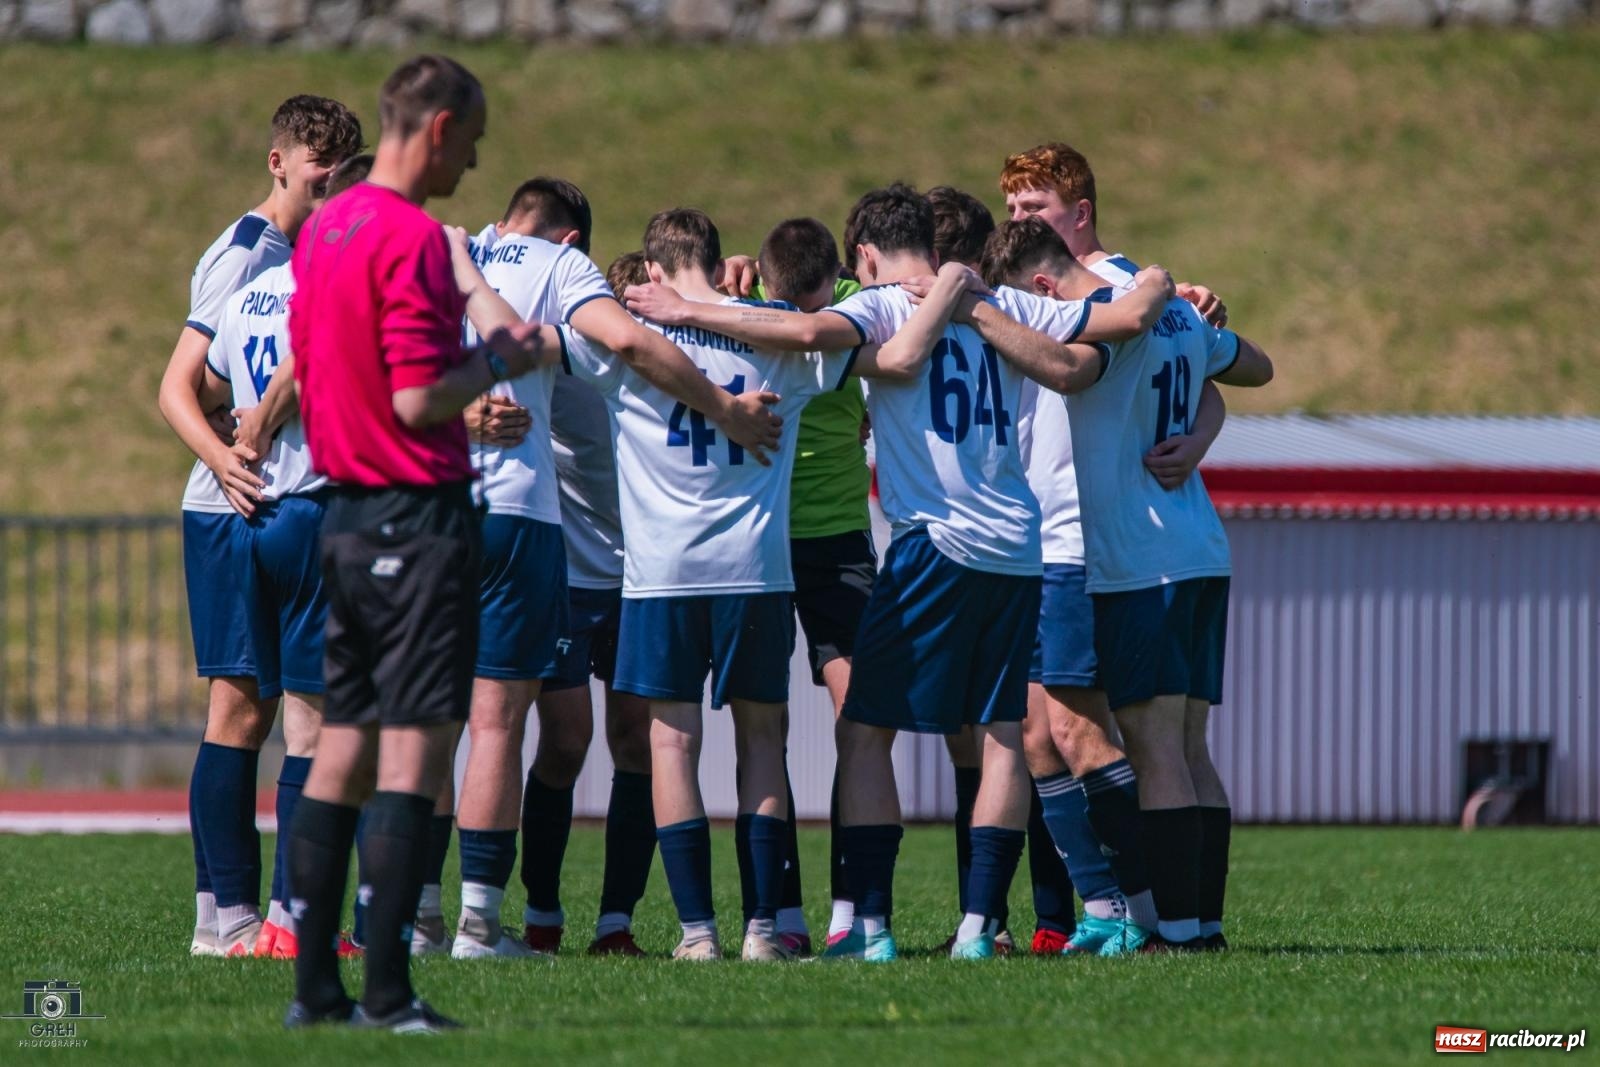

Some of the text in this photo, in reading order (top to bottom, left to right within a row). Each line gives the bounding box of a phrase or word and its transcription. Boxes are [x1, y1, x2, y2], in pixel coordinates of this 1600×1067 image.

[667, 369, 746, 467] 41
[929, 337, 1012, 446] 64
[1152, 354, 1191, 446] 19
